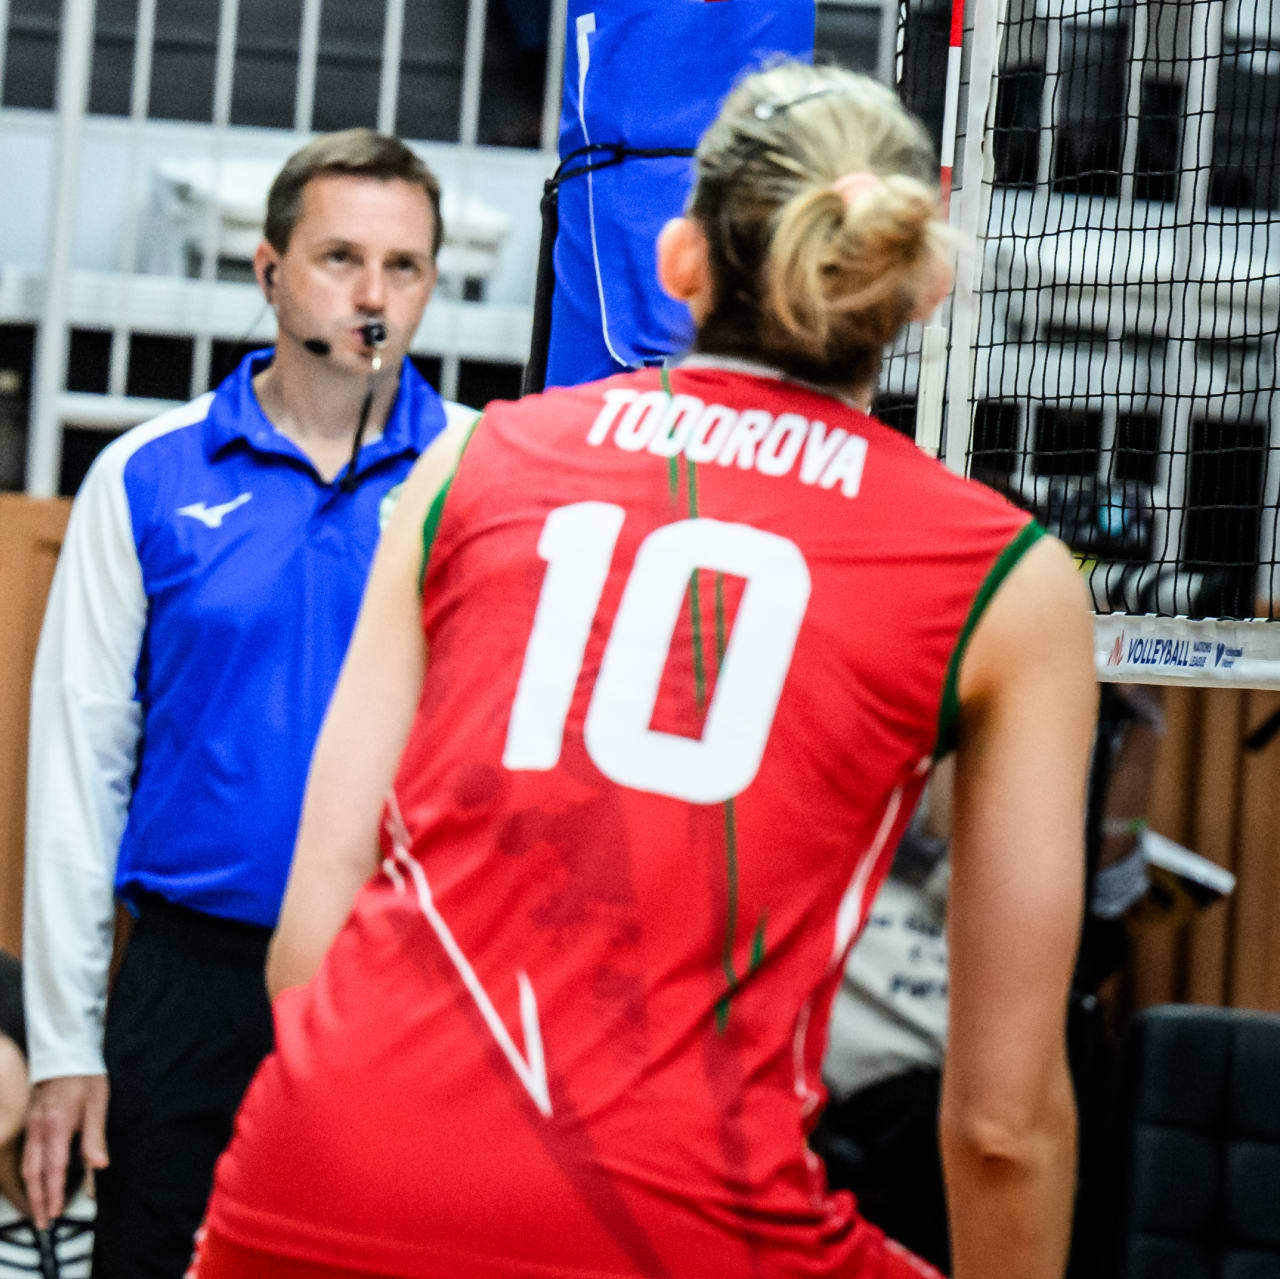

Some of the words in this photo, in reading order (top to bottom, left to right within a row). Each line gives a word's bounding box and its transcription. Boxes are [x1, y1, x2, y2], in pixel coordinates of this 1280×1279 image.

[586, 388, 869, 499] TODOROVA
[501, 500, 813, 806] 10
[1126, 637, 1190, 667] VOLLEYBALL
